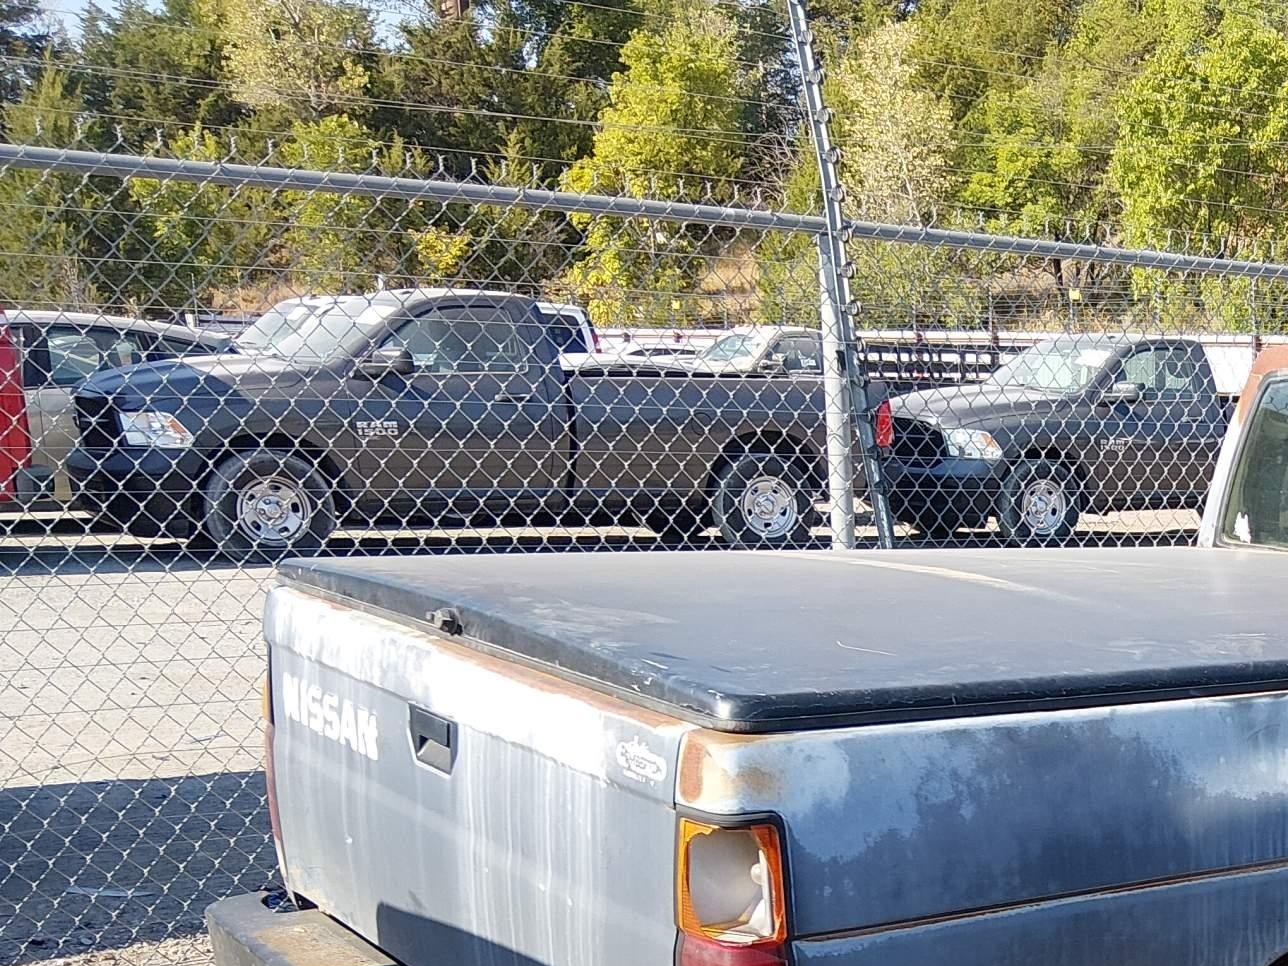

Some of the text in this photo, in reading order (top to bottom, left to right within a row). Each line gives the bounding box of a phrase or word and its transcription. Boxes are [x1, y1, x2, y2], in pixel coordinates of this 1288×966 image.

[356, 420, 398, 428] RAM
[357, 428, 399, 436] 1500
[282, 671, 379, 761] NISSAN
